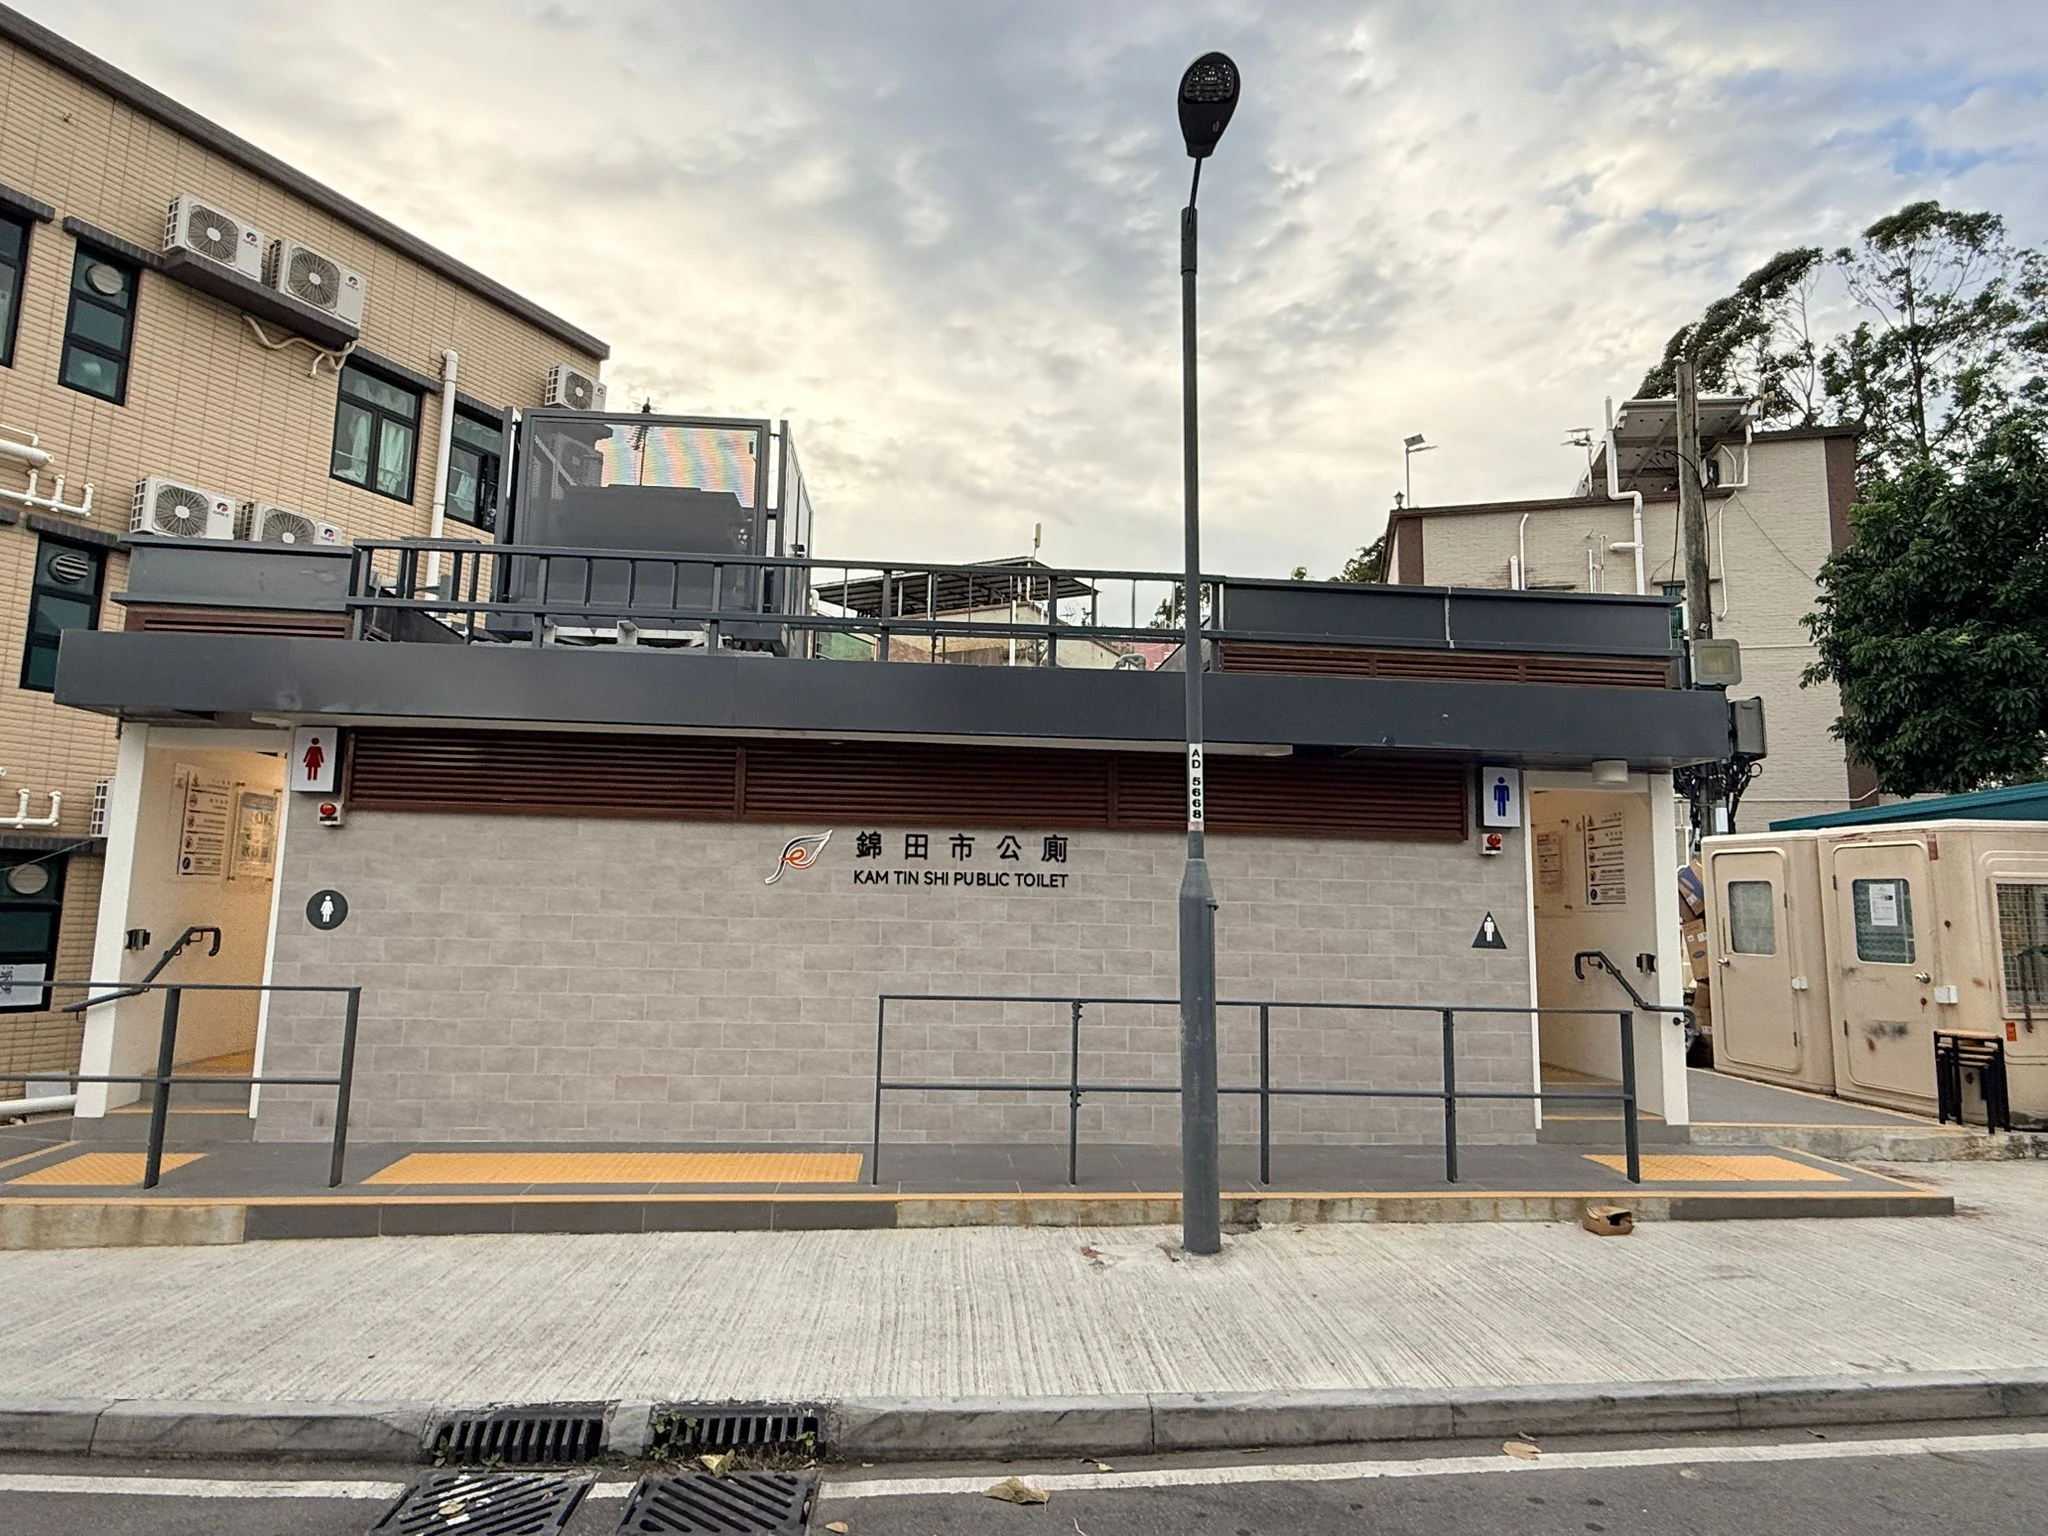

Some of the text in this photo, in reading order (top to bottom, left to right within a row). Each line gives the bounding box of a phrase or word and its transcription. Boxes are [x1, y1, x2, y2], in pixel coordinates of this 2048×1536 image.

[855, 830, 1069, 863] 錦田市公廁
[853, 869, 1069, 888] KAM TIN SHI PUBLIC TOILET
